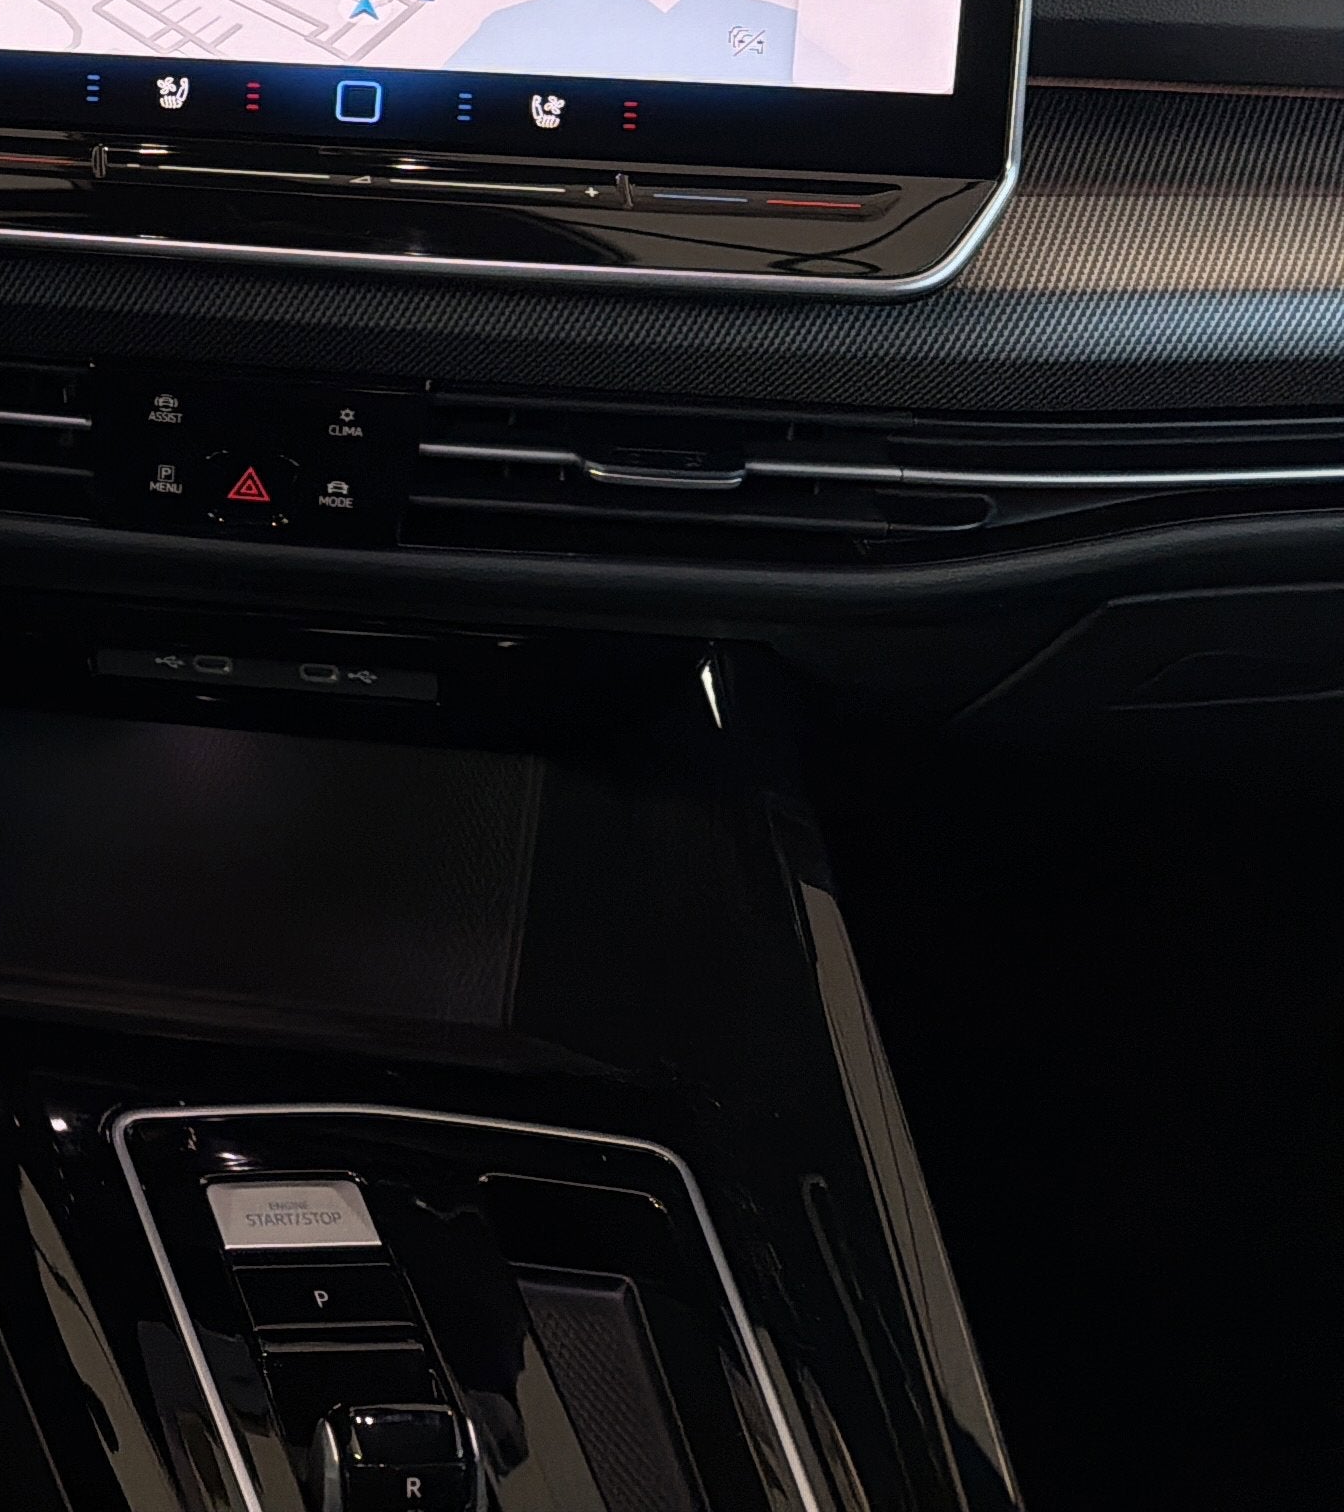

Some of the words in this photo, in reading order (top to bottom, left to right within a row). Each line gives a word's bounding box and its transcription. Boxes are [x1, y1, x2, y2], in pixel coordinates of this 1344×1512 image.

[148, 410, 183, 424] ASSIST
[328, 425, 363, 437] CLIMA
[149, 481, 183, 494] MENU
[318, 496, 354, 509] MODE
[268, 1199, 309, 1210] ENGINE
[245, 1211, 342, 1227] START/STOP
[313, 1290, 329, 1309] P
[406, 1477, 422, 1498] R
